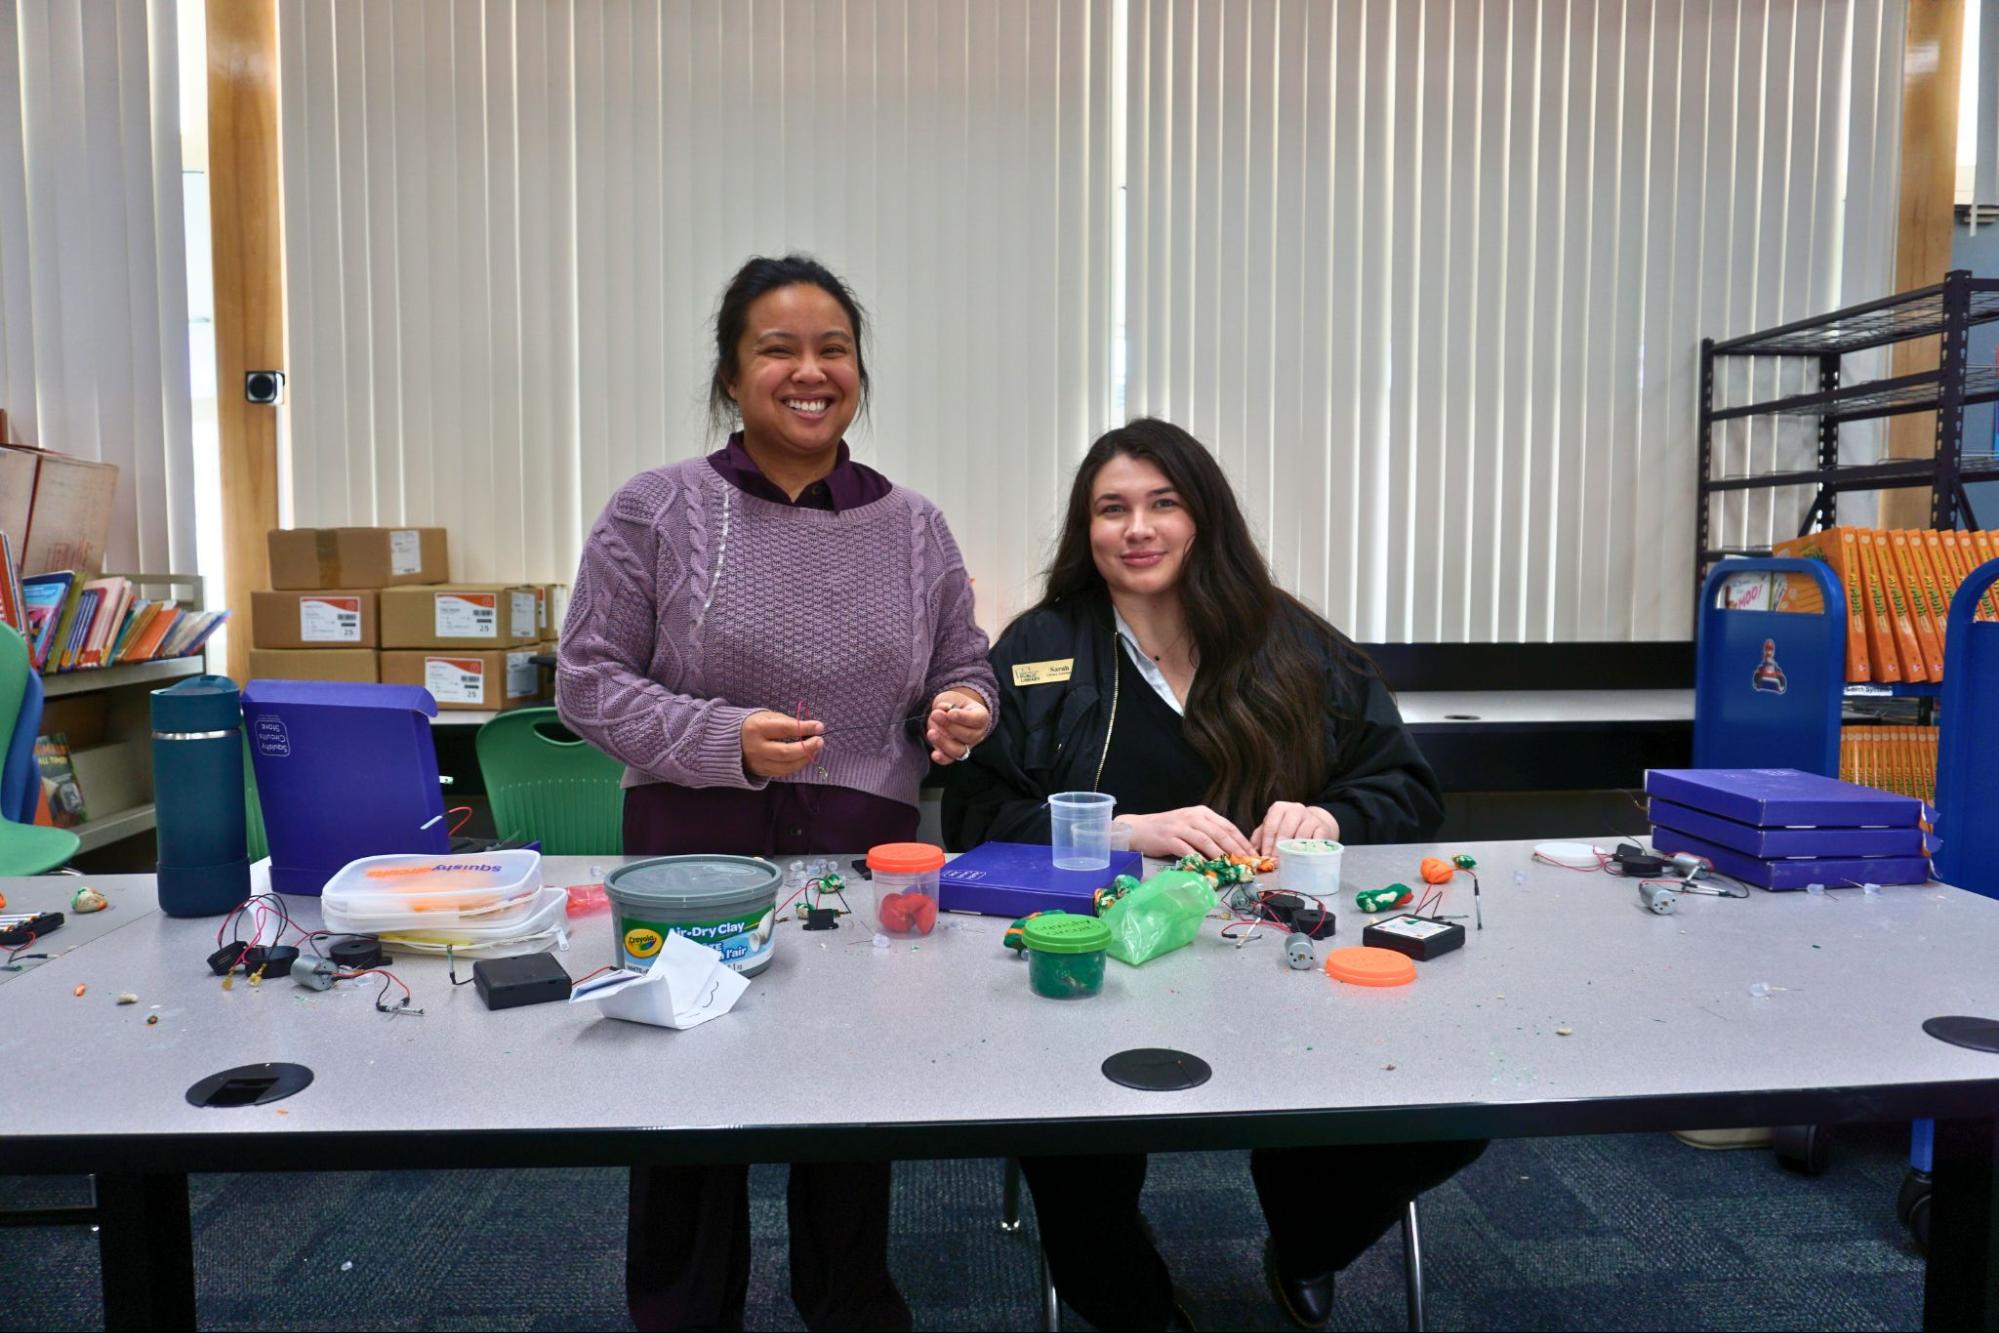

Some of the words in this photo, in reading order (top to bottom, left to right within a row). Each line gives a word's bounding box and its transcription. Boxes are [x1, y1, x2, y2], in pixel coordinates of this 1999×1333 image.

[261, 723, 280, 732] Store
[718, 922, 745, 934] Clay
[627, 934, 655, 944] Crayola
